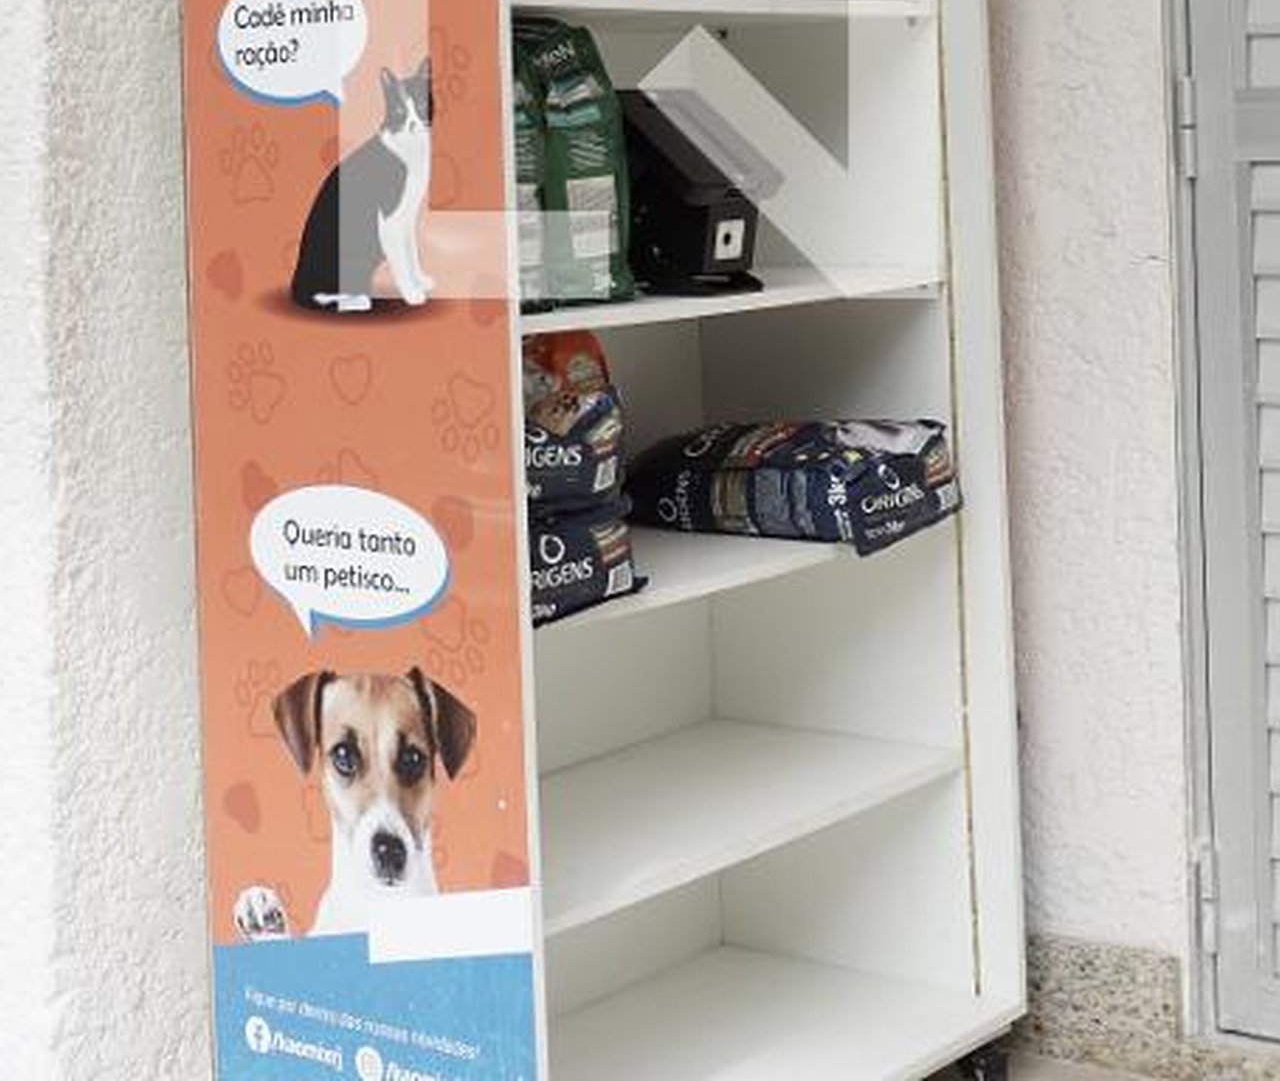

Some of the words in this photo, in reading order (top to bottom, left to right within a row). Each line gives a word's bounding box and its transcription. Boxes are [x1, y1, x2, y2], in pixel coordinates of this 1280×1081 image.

[233, 2, 286, 30] Cadê
[234, 38, 300, 71] ração?
[525, 444, 583, 469] IGENS
[282, 519, 352, 550] Queria
[358, 528, 417, 557] tanto
[284, 563, 318, 583] um
[323, 565, 411, 595] petisco...
[533, 556, 594, 590] RIGENS
